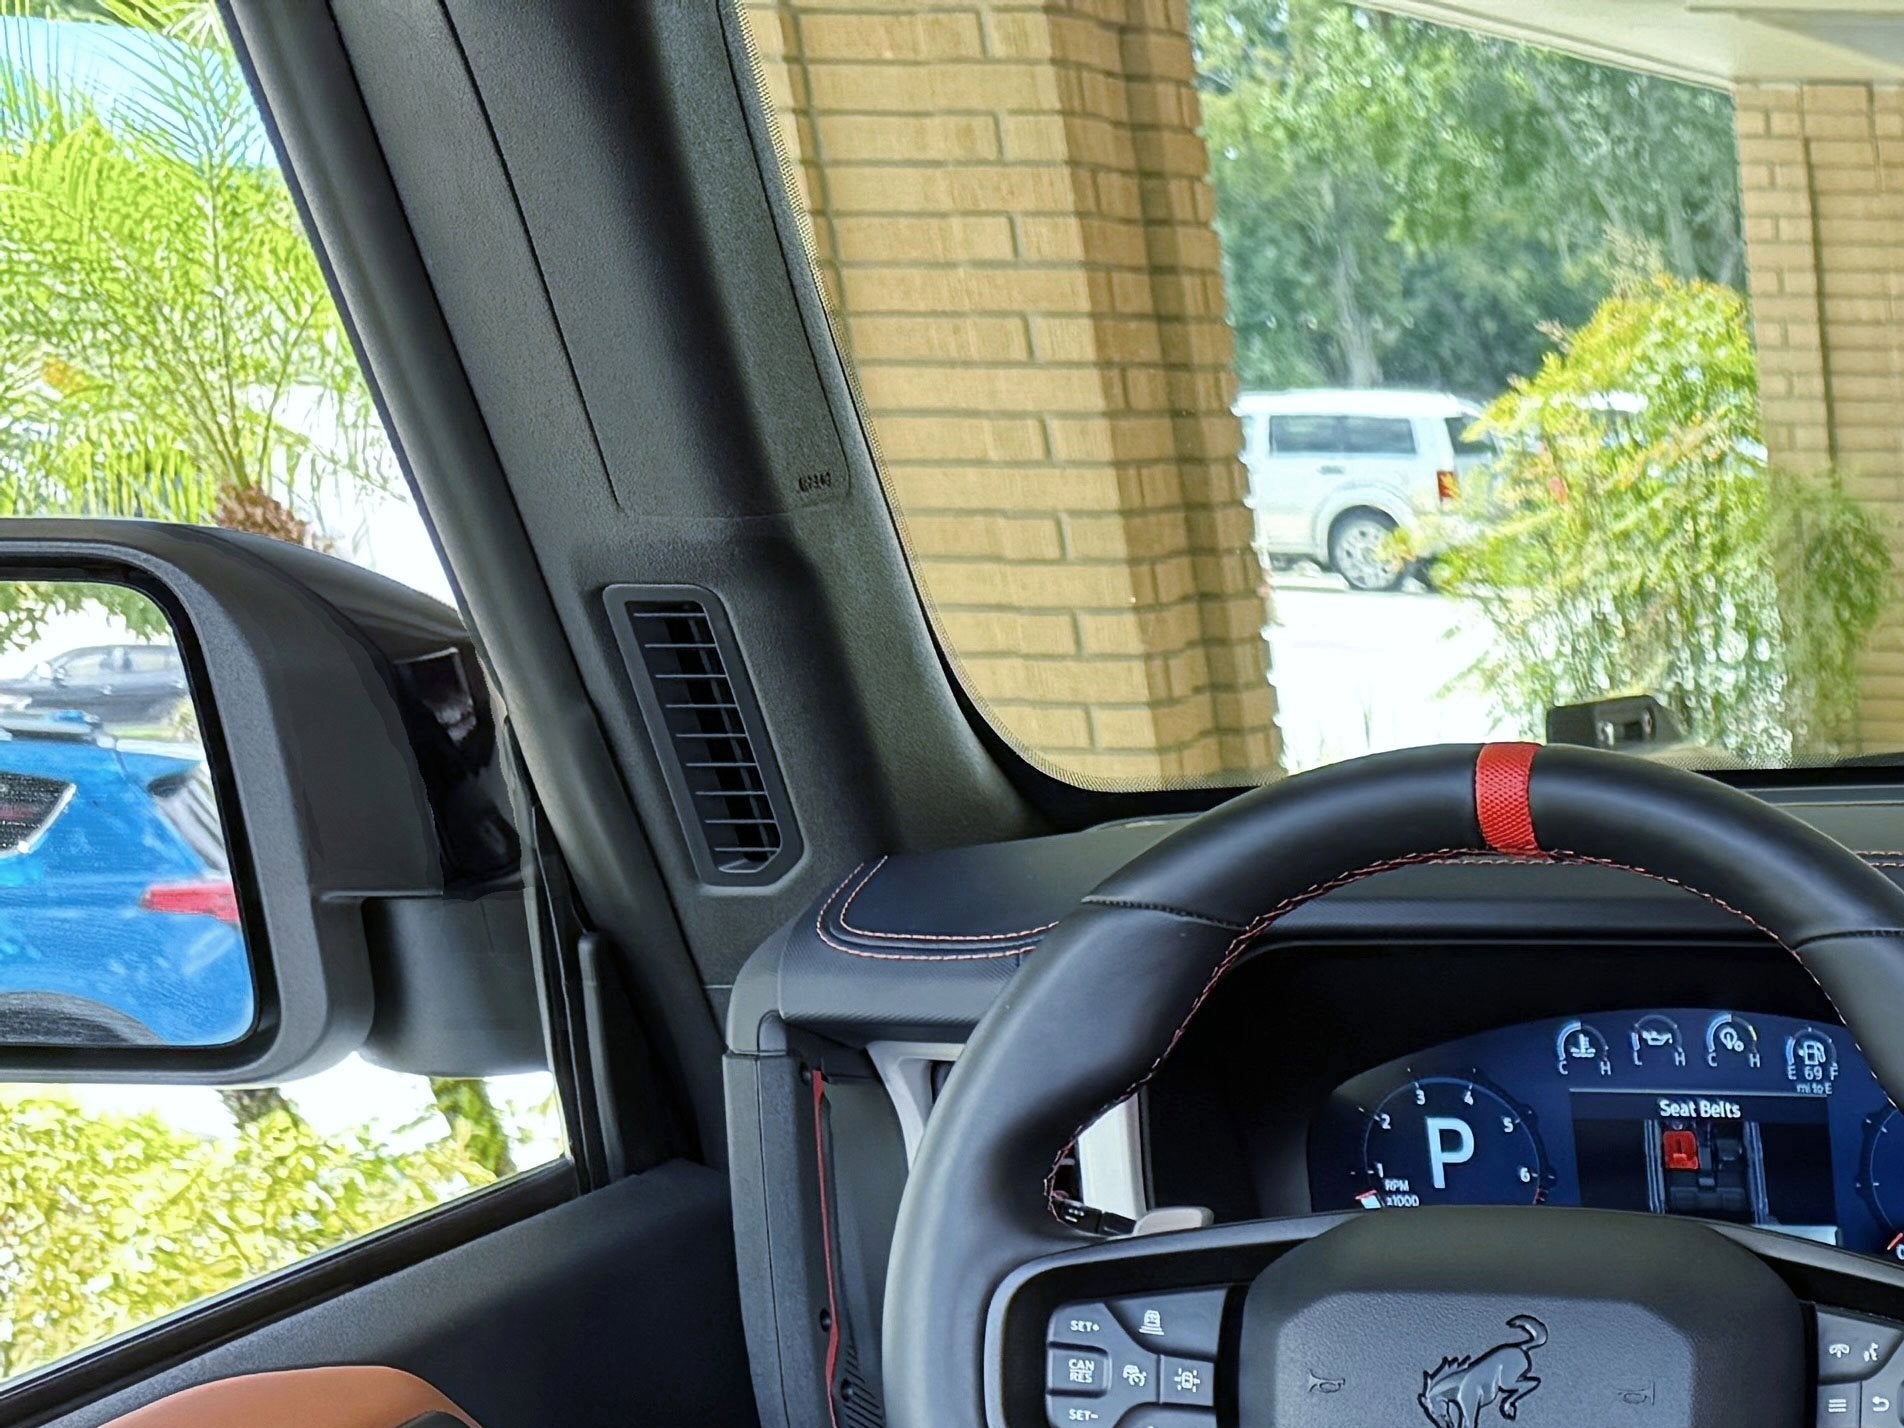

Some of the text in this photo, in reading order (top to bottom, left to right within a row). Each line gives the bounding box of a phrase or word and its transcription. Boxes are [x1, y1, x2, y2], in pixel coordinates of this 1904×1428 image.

[1804, 1065, 1823, 1080] 69
[1416, 1090, 1426, 1105] 3
[1464, 1090, 1474, 1106] 4
[1660, 1101, 1741, 1119] Seat Belts
[1380, 1114, 1391, 1130] 2
[1503, 1117, 1514, 1133] 5
[1425, 1116, 1475, 1189] P
[1375, 1163, 1384, 1179] 1
[1519, 1167, 1531, 1183] 6
[1384, 1178, 1410, 1192] RPM
[1068, 1358, 1095, 1371] CAN
[1069, 1371, 1093, 1384] RES
